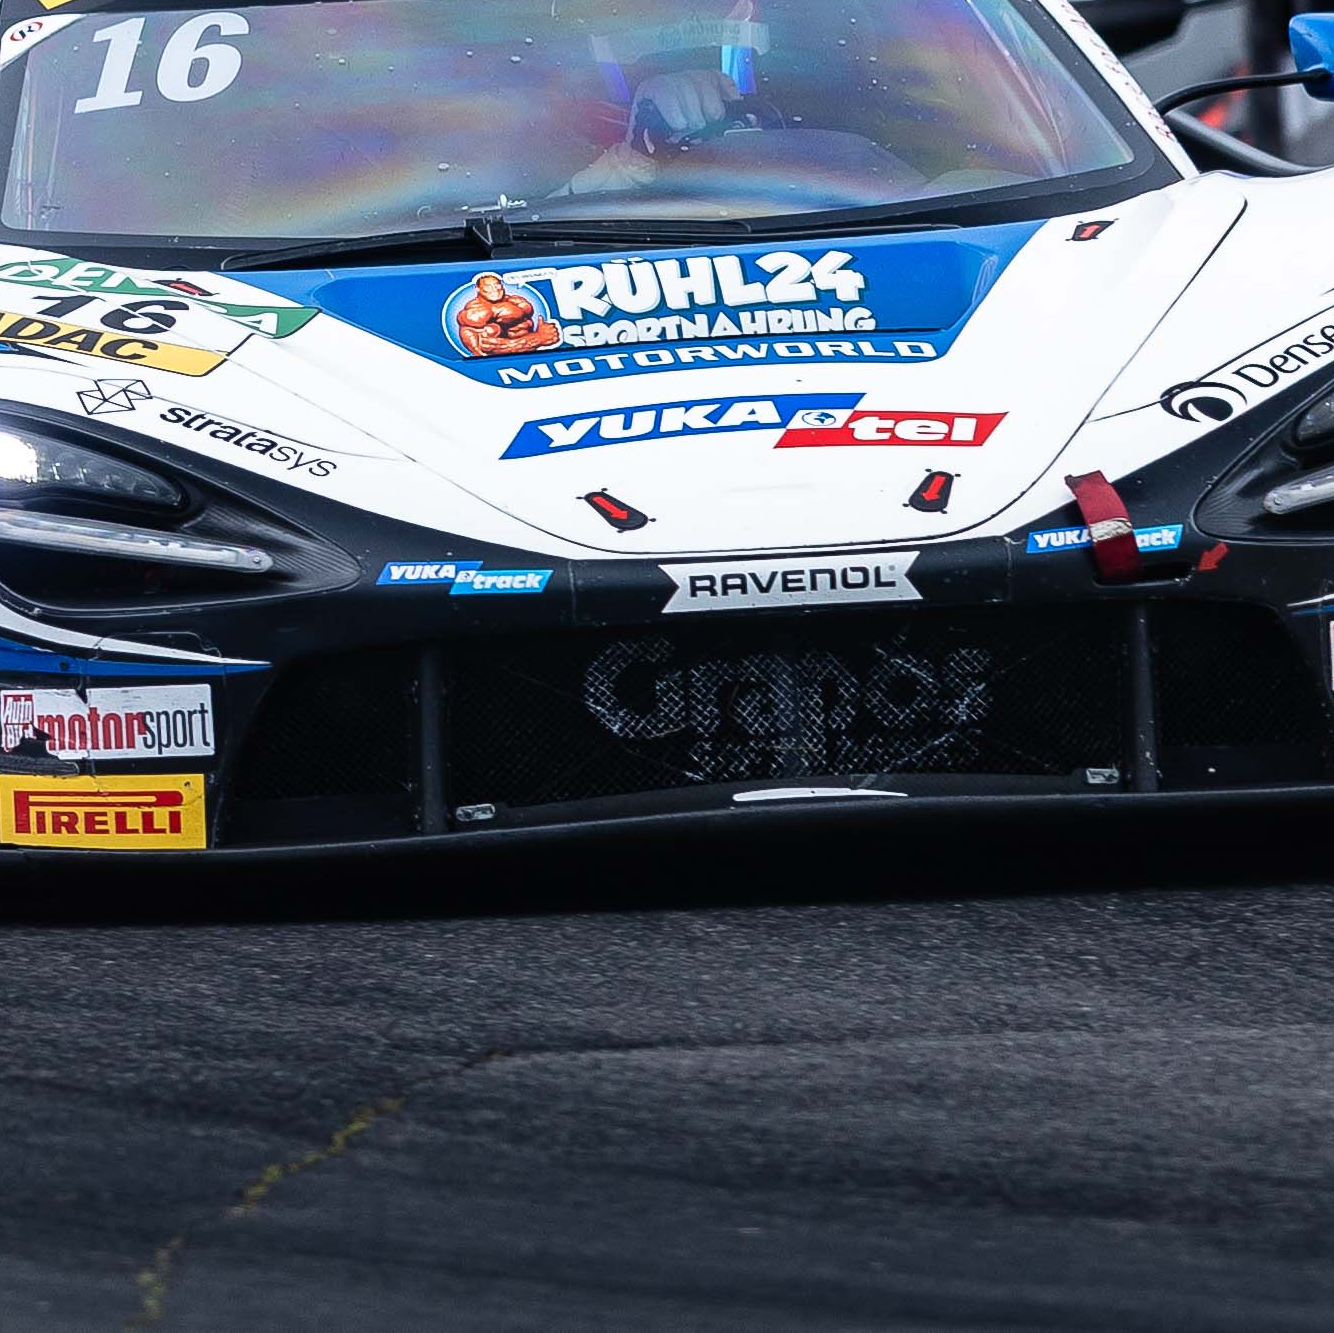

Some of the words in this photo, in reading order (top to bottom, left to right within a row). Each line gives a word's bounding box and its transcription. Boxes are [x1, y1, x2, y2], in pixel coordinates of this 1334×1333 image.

[74, 12, 250, 114] 16
[553, 250, 866, 320] RÜHL24
[32, 294, 190, 334] 16
[562, 306, 876, 348] SPORTNAHRUNG
[498, 339, 937, 385] MOTORWORLD
[160, 406, 338, 478] stratasys
[537, 399, 782, 448] YUKA
[848, 415, 977, 443] tel
[1136, 529, 1177, 547] ack
[389, 564, 456, 581] YUKA
[472, 572, 545, 590] track
[689, 566, 897, 598] RAVENOL
[4, 696, 33, 724] Auto
[13, 789, 184, 835] PIRELLI
